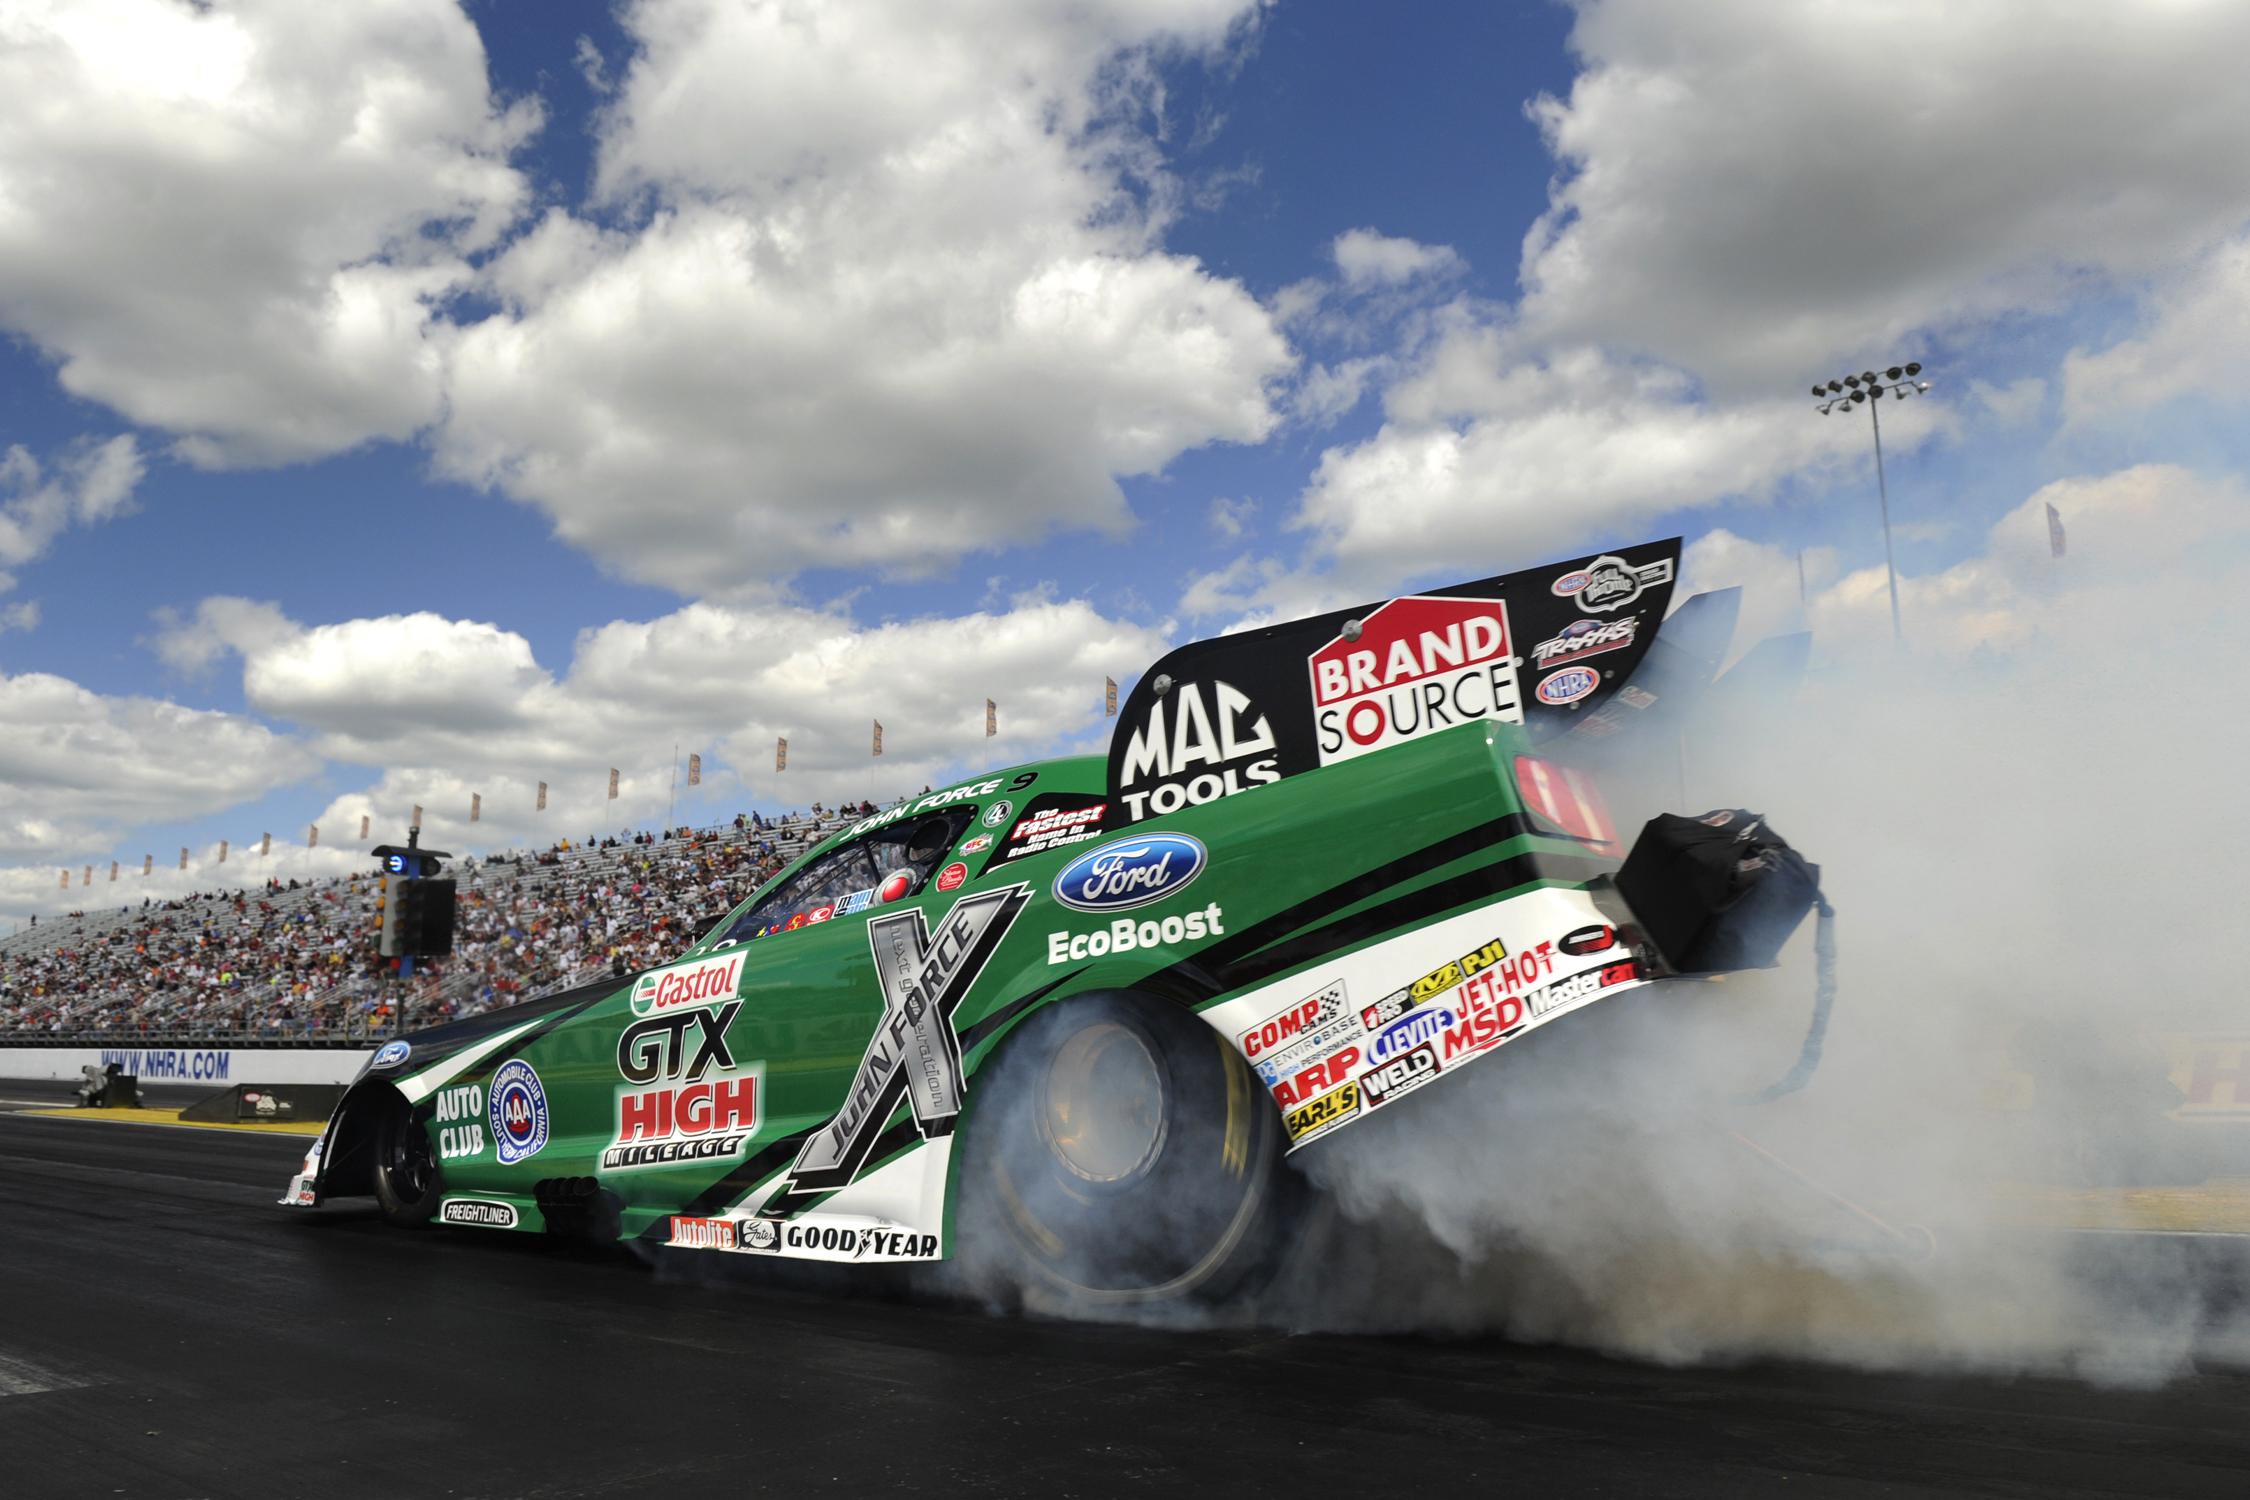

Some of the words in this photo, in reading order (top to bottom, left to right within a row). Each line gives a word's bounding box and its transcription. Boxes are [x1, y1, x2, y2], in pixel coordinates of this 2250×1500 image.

[1318, 615, 1503, 702] BRAND
[1531, 617, 1636, 660] TRAXXAS
[1319, 661, 1516, 754] SOURCE
[1544, 671, 1593, 699] NHRA
[1120, 680, 1278, 788] MAC
[1006, 772, 1040, 793] 9
[1121, 764, 1282, 822] TOOLS
[839, 803, 911, 842] JOHN
[912, 777, 1004, 813] FORCE
[1012, 806, 1104, 840] Fastest
[1034, 808, 1059, 821] The
[1007, 841, 1048, 858] Radio
[1048, 829, 1102, 849] Control
[1027, 828, 1067, 845] Name
[1082, 847, 1173, 900] Ford
[1047, 902, 1225, 965] EcoBoost
[1461, 941, 1506, 975] PJ1
[656, 958, 737, 1008] Castrol
[617, 998, 746, 1085] GTX
[832, 1040, 894, 1162] JOHN
[890, 911, 974, 1052] FORCE
[1244, 999, 1320, 1057] COMP
[1300, 1009, 1338, 1035] CAMS
[1369, 1010, 1449, 1065] CLEVITE
[1444, 996, 1522, 1060] MSD
[101, 1050, 229, 1080] WWW.NHRA.COM
[1279, 1063, 1301, 1078] HIGH
[1301, 1029, 1363, 1067] PERFORMANCE
[1362, 1048, 1434, 1096] WELD
[491, 1065, 527, 1106] AUTOMOBILE
[525, 1073, 541, 1101] CLUB
[1273, 1046, 1360, 1111] ARP
[1382, 1069, 1437, 1100] RACING
[436, 1085, 482, 1122] AUTO
[505, 1098, 531, 1124] AAA
[619, 1076, 757, 1145] HIGH
[1288, 1085, 1355, 1136] EARL'S
[440, 1124, 485, 1160] CLUB
[492, 1114, 516, 1159] SOUTHERN
[514, 1107, 546, 1159] CALIFORNIA
[603, 1134, 747, 1169] MILEAGE
[446, 1205, 510, 1224] FREIGHTLINER
[674, 1218, 732, 1249] Autolite
[744, 1221, 776, 1243] Gates
